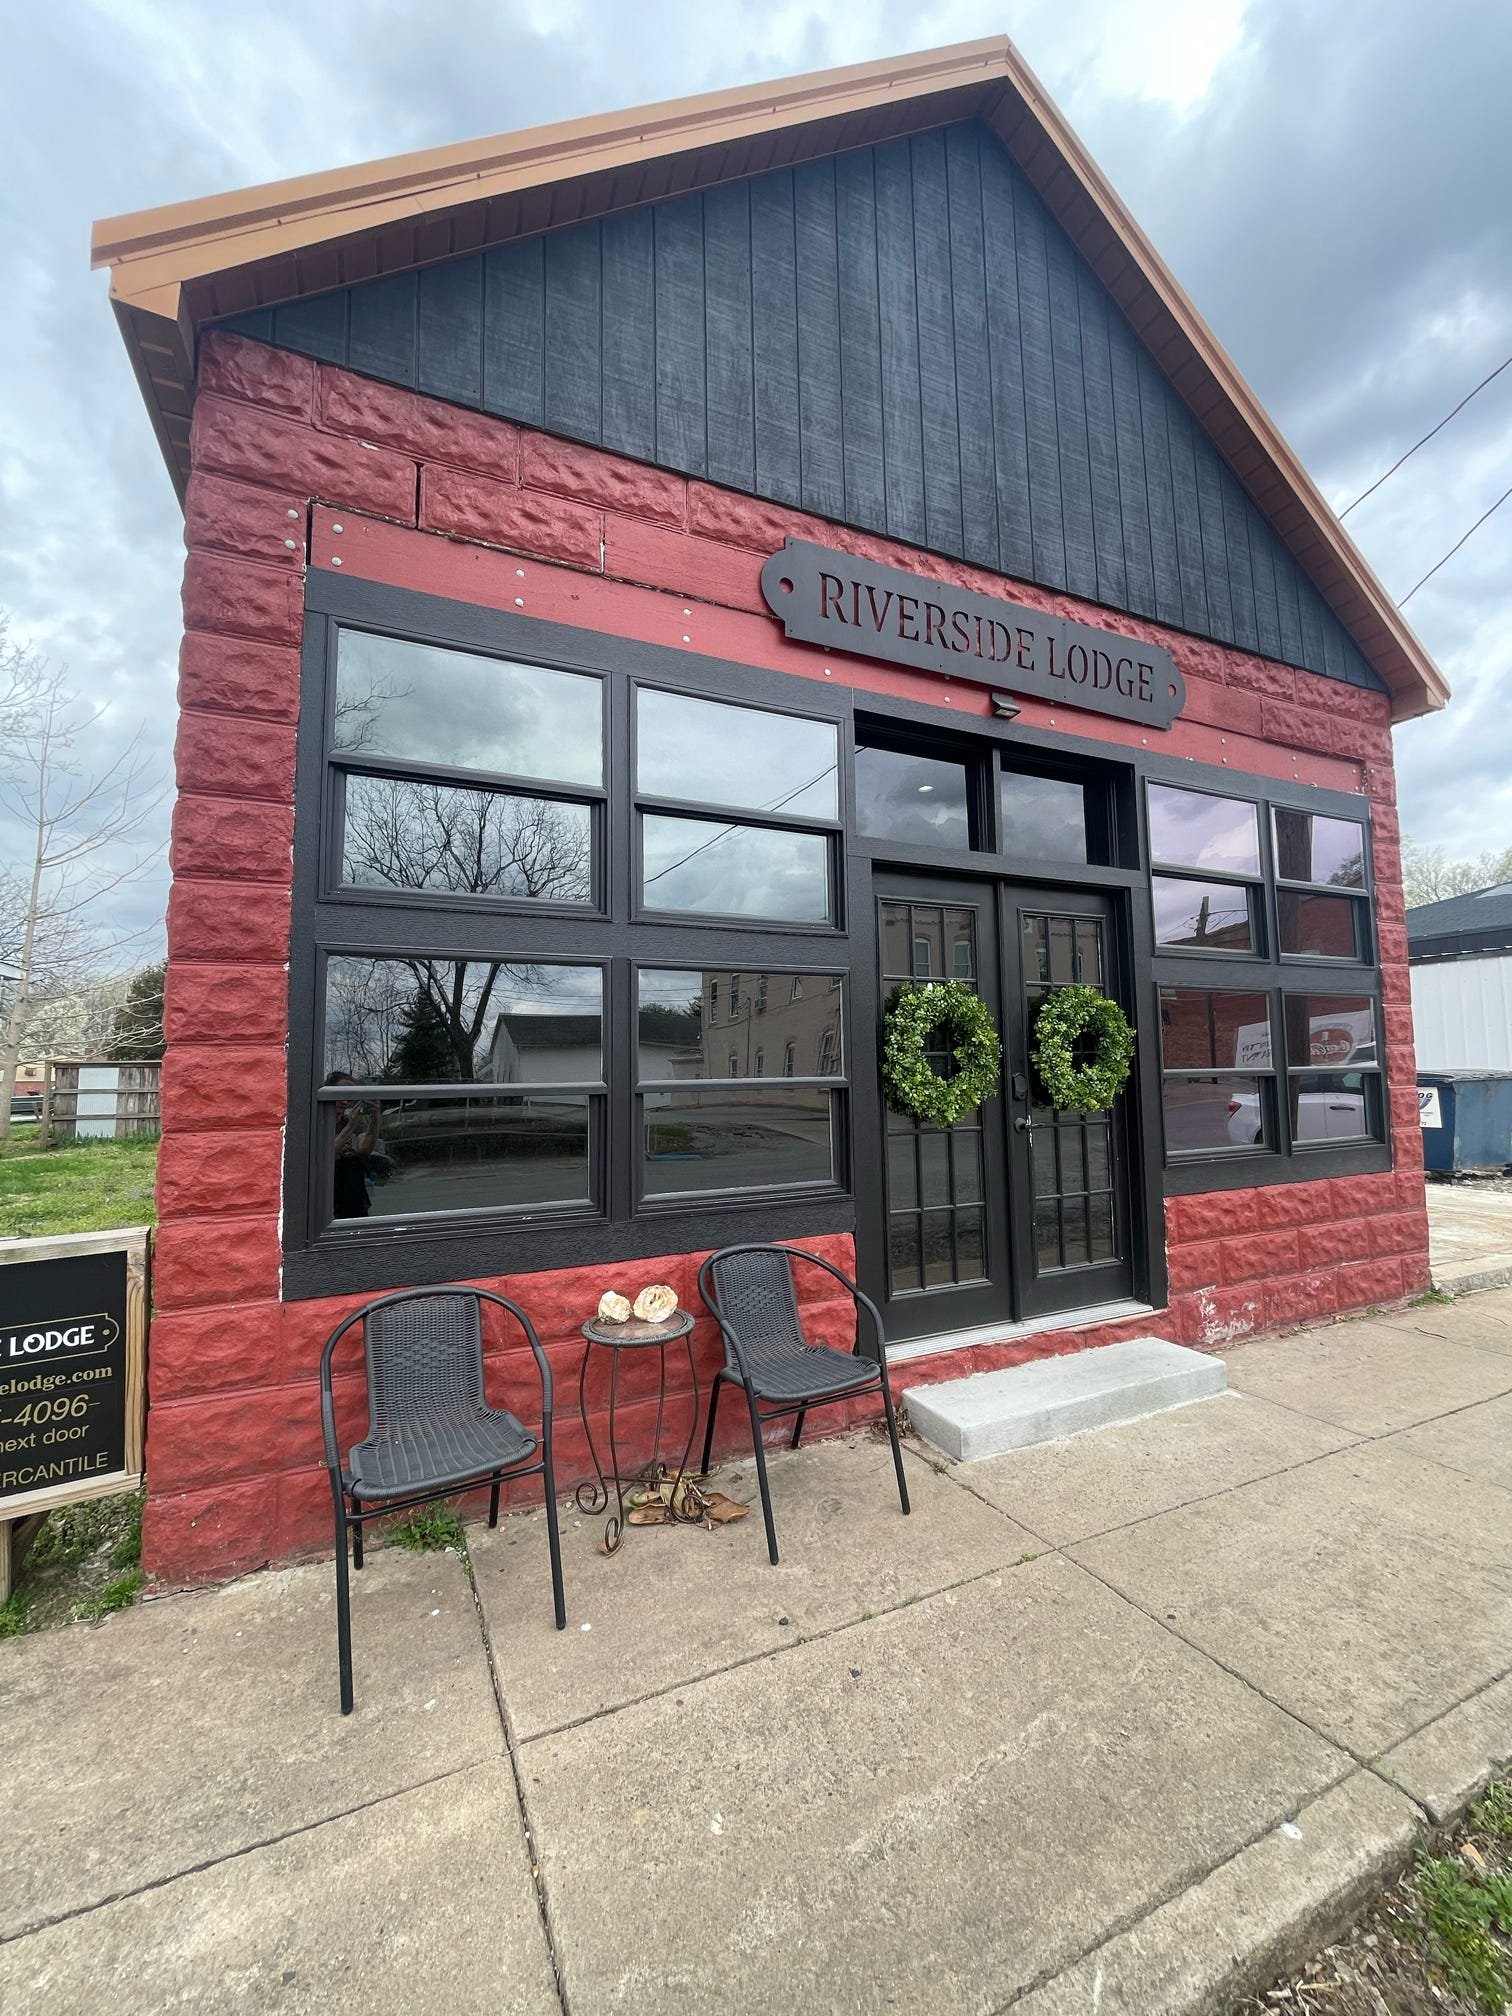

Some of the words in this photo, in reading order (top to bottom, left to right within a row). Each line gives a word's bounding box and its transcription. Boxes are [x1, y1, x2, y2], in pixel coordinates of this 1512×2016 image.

[817, 572, 1036, 672] RIVERSIDE
[1046, 636, 1155, 703] LODGE
[9, 1325, 95, 1357] LODGE
[0, 1366, 113, 1396] elodge.com
[0, 1394, 90, 1427] -4096
[42, 1424, 90, 1445] door
[0, 1451, 109, 1488] RCANTILE
